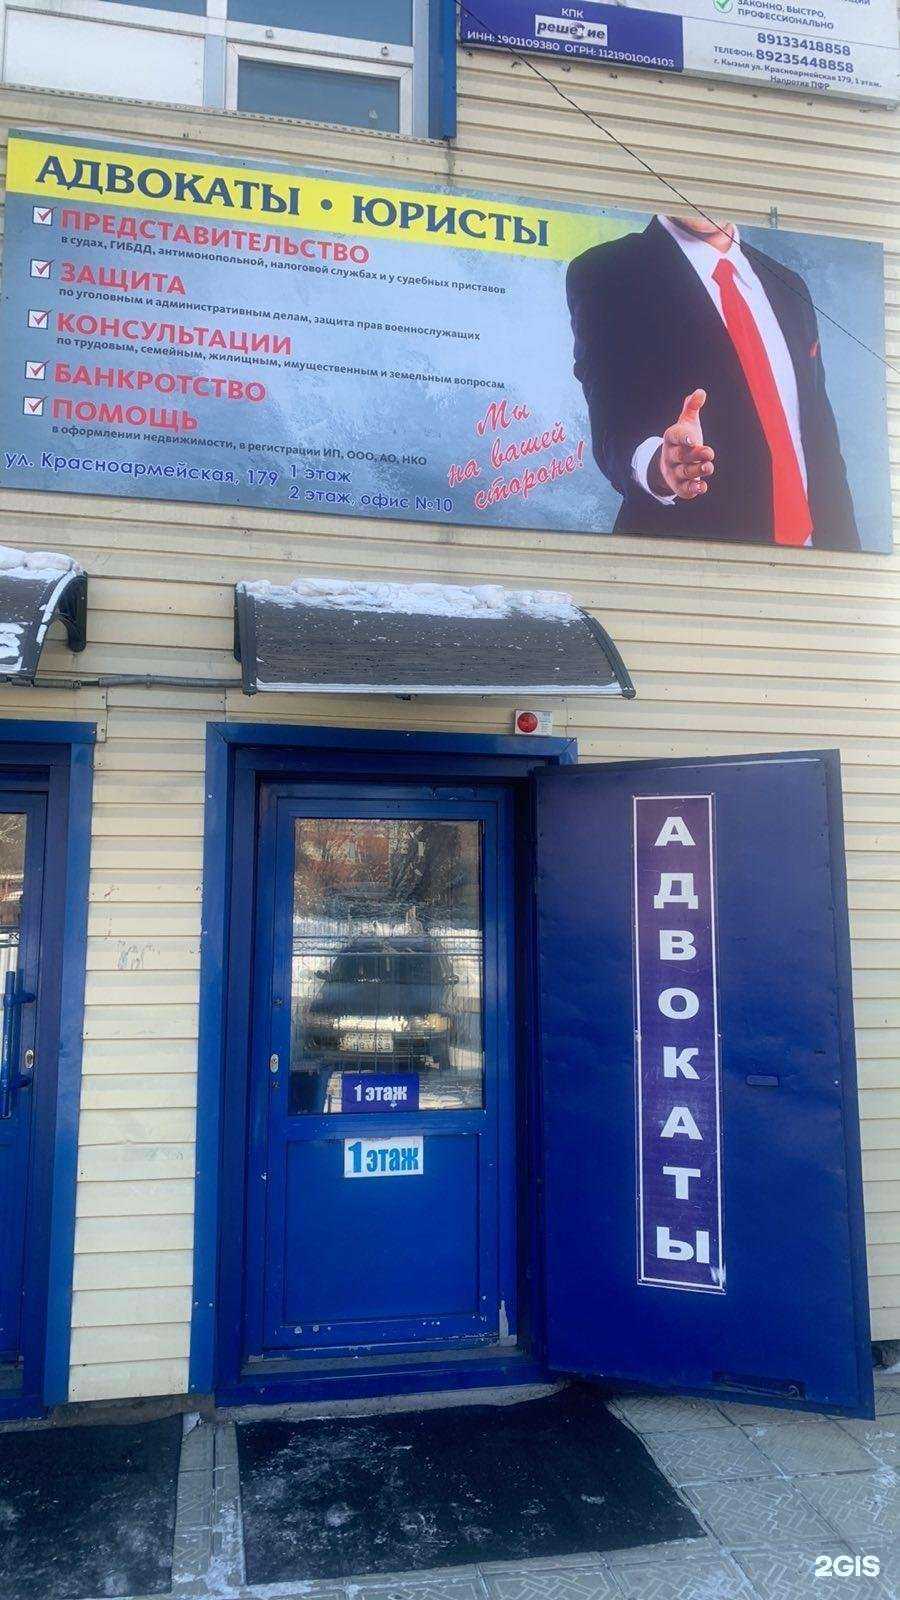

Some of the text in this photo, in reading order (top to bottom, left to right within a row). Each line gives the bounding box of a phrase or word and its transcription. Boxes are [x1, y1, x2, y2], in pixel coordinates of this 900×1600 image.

[561, 8, 584, 18] КПК
[738, 8, 834, 29] ПРОФЕССИОНАЛЬНО
[466, 31, 675, 67] ИНН: 1901109380 ОГРН: 1121901004103
[756, 50, 855, 73] 89235448858
[757, 32, 851, 56] 89133418858
[811, 81, 831, 91] ПФР
[35, 155, 549, 247] АДВОКАТЫ ЮРИСТЫ
[60, 208, 370, 264] ПРЕДСТАВИТЕЛЬСТВО
[60, 262, 187, 295] ЗАЩИТА
[61, 237, 506, 294] в судах, ГИБДД, антимонопольной, налоговой службах и у судебных приставов
[59, 288, 481, 341] по уголовным и административным делам, защита прав военнослужащих
[57, 312, 292, 356] КОНСУЛЬТАЦИИ
[57, 337, 72, 346] по
[74, 339, 138, 354] трудовым,
[140, 345, 207, 361] семейным,
[208, 353, 281, 369] жилищным,
[283, 361, 378, 377] имущественным
[389, 371, 452, 384] земельным
[454, 377, 505, 390] вопросам
[54, 362, 267, 402] БАНКРОТСТВО
[52, 398, 199, 433] ПОМОЩЬ
[475, 399, 531, 437] Мы
[52, 425, 427, 466] в оформлении недвижимости, в регистрации ИП, ООО, АО, НКО
[449, 421, 567, 487] на вашей
[5, 452, 279, 487] ул. Красноармейская, 179
[289, 465, 352, 483] 1 этаж
[474, 440, 585, 510] стороне!
[288, 486, 453, 512] 2 этаж, офис №10
[654, 816, 710, 1264] АДВОКАТЫ
[354, 1084, 408, 1102] 1 этаж
[348, 1141, 419, 1173] 1 этаж
